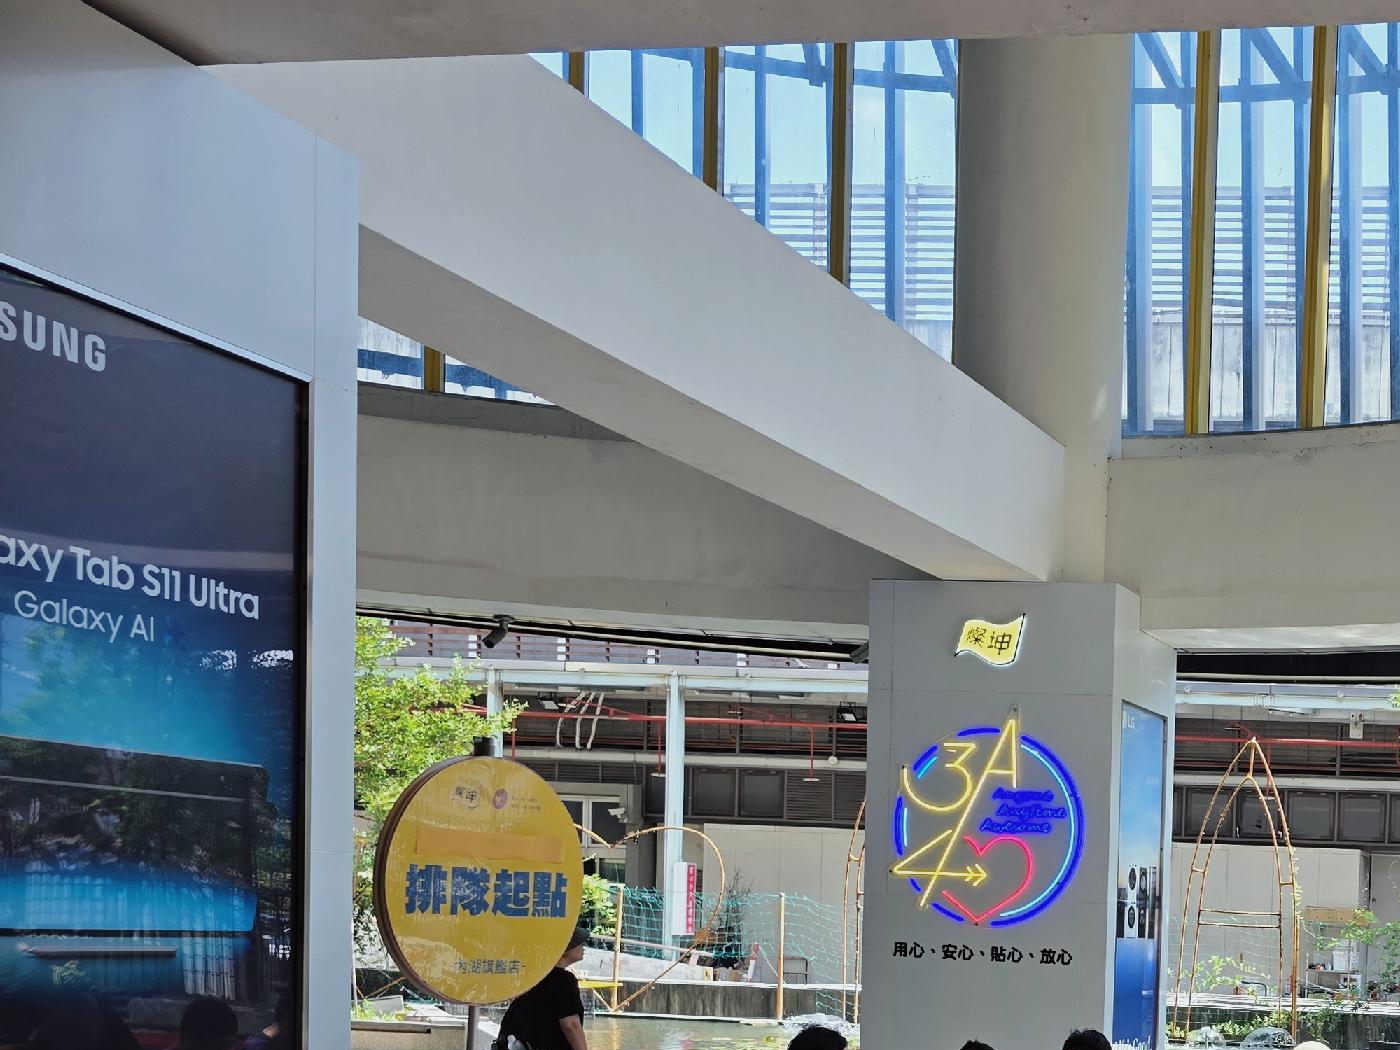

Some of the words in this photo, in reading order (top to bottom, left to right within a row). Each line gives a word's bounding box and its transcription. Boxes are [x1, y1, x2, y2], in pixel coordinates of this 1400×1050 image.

[69, 545, 135, 590] Tab
[141, 562, 181, 602] S11
[189, 574, 260, 619] Ultra
[14, 590, 124, 643] Galaxy
[130, 614, 155, 642] AI
[966, 626, 1012, 656] 燦坤
[404, 863, 568, 918] 排隊起點
